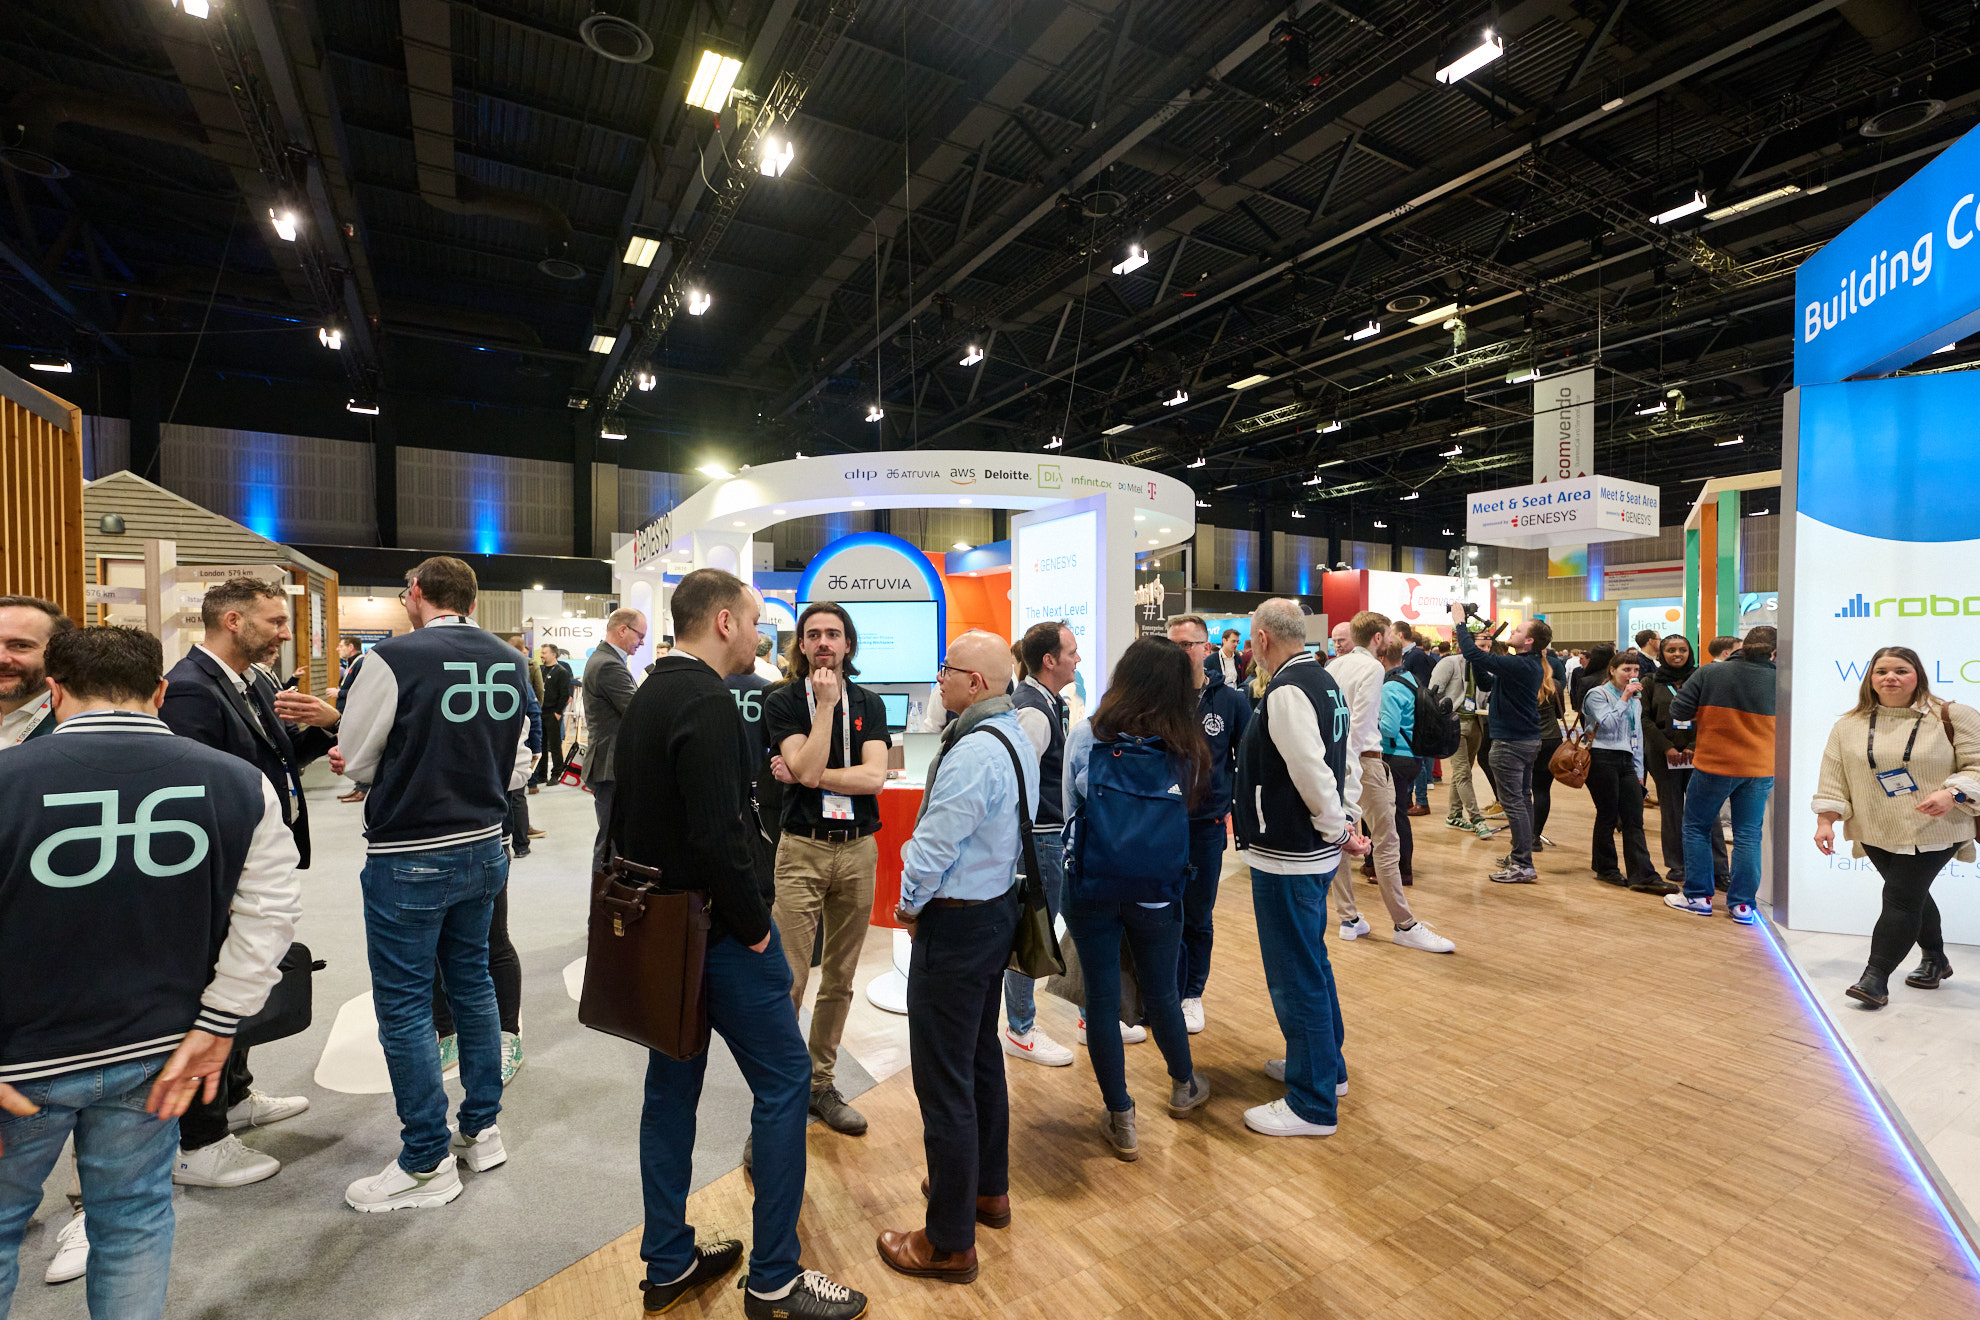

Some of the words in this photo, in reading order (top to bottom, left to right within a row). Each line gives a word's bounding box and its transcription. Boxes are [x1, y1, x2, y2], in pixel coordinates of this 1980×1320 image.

[1805, 231, 1933, 344] Building
[1946, 193, 1980, 250] C
[1556, 387, 1572, 479] comvendo
[950, 468, 976, 479] aws
[984, 469, 1032, 481] Deloitte.
[1472, 500, 1504, 514] Meet
[1508, 498, 1518, 510] &
[1522, 493, 1552, 508] Seat
[1557, 490, 1592, 504] Area
[1600, 486, 1618, 501] Meet
[1619, 490, 1625, 502] &
[1626, 491, 1641, 505] Seat
[1643, 495, 1658, 508] Area
[1521, 509, 1578, 527] GENESYS
[1626, 511, 1652, 526] GENESYS
[1041, 554, 1077, 572] GENESYS
[1026, 607, 1041, 619] The
[1043, 605, 1062, 618] Next
[1064, 601, 1088, 616] Level
[542, 626, 593, 637] XIMES
[1630, 620, 1668, 631] client
[18, 717, 41, 740] GENESYS
